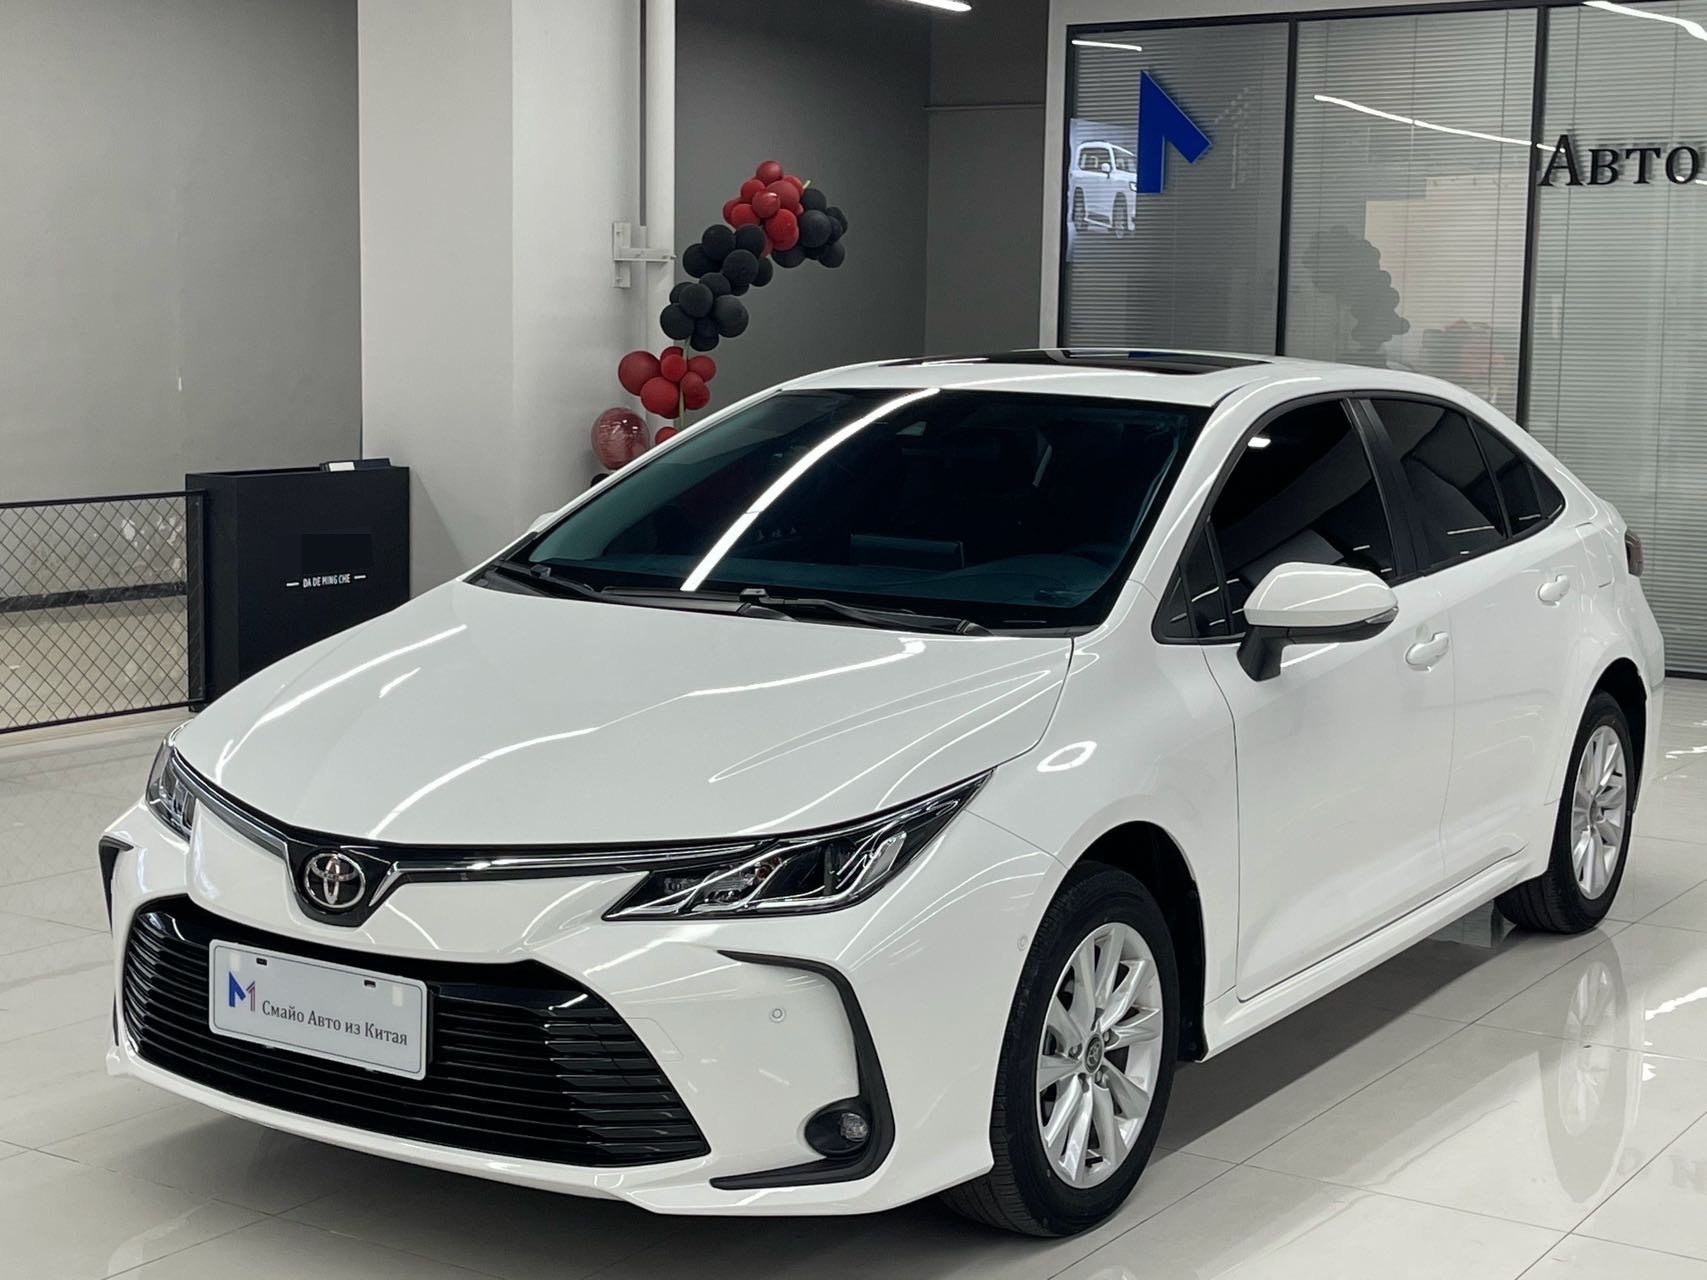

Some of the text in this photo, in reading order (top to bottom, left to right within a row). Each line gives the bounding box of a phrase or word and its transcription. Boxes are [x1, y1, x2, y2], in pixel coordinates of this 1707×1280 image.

[303, 573, 351, 588] DA DE MING CHE
[262, 1000, 408, 1046] Смайо Авто из Китая
